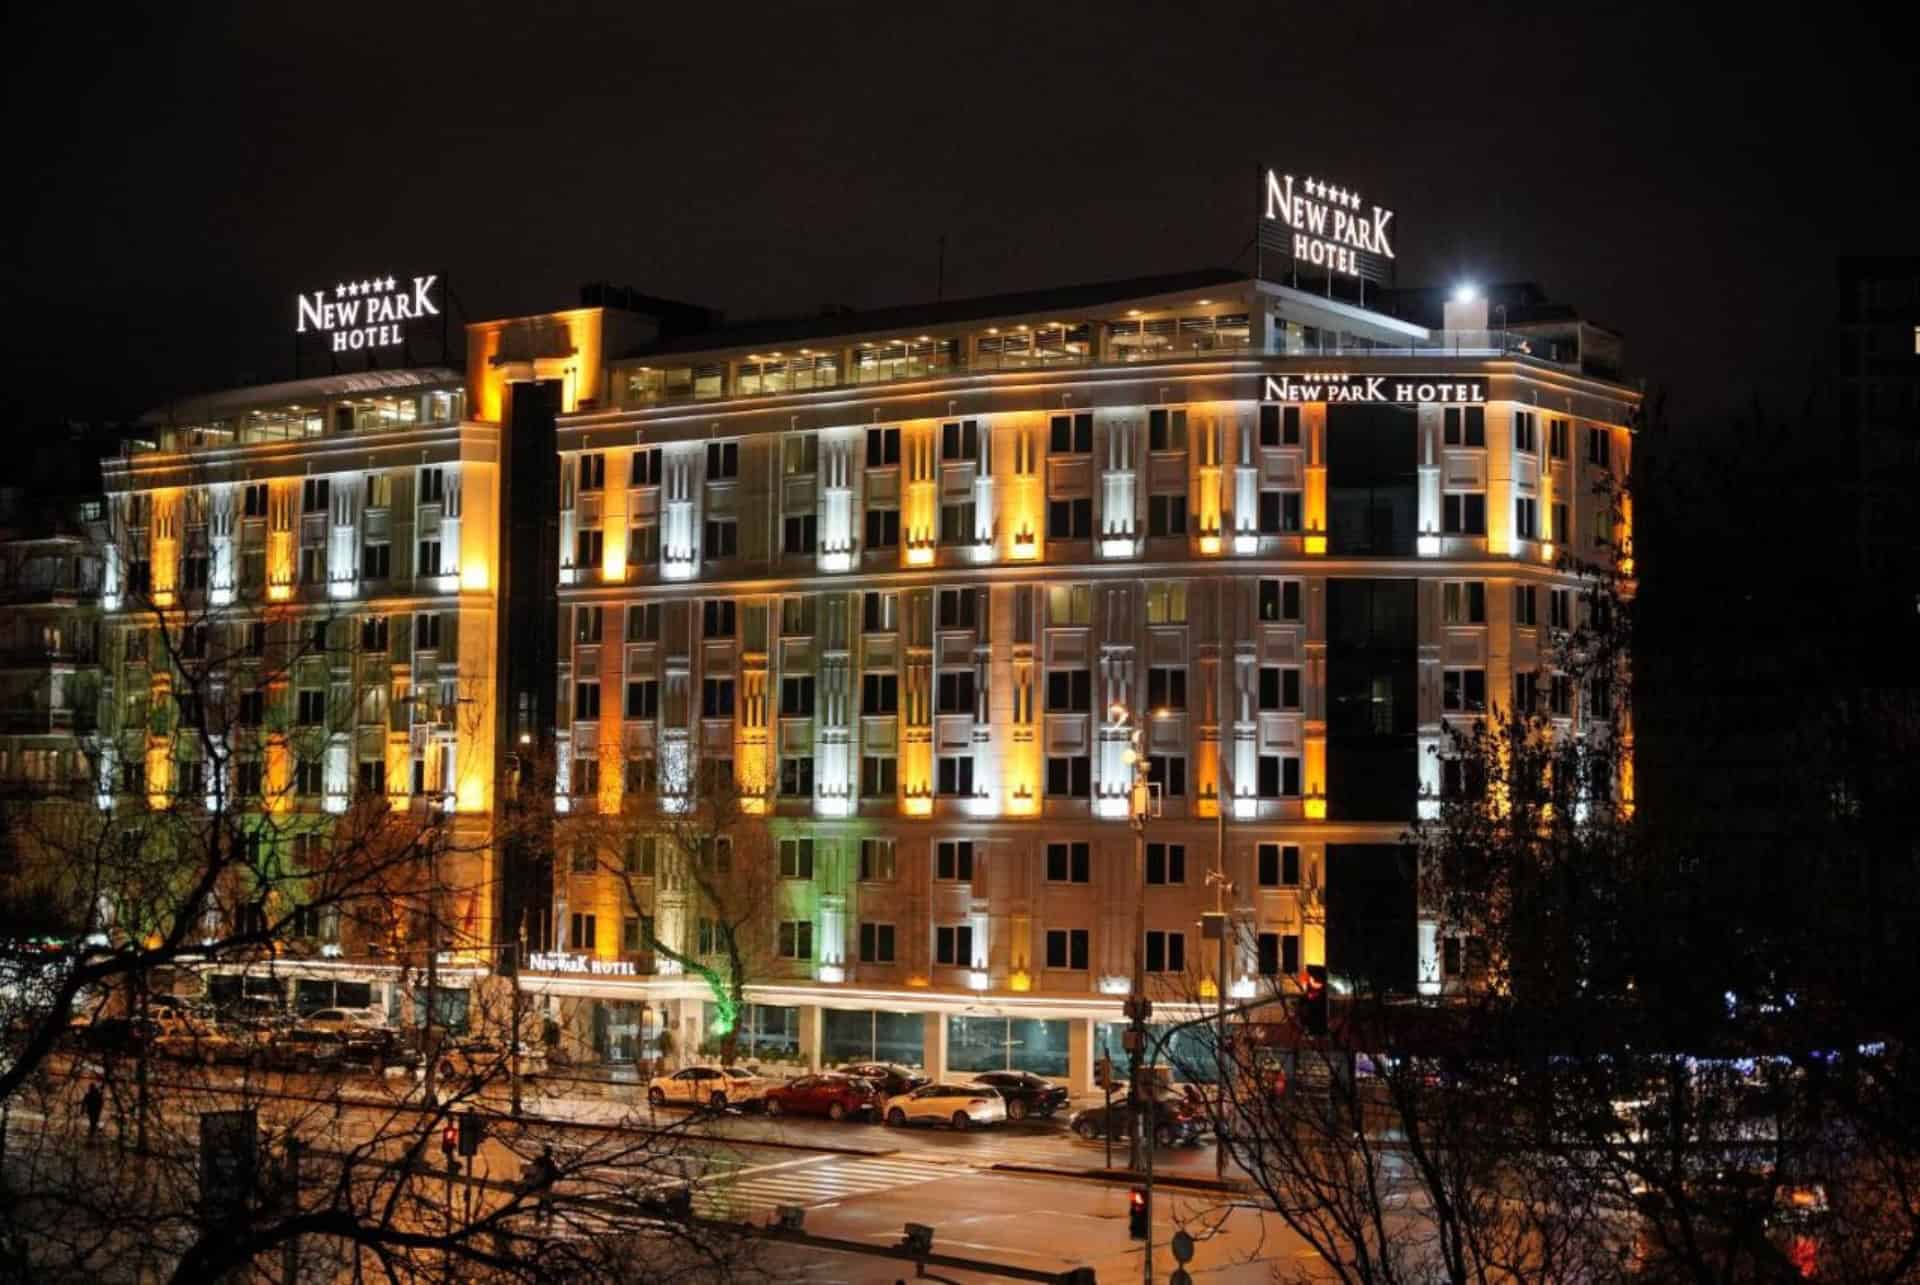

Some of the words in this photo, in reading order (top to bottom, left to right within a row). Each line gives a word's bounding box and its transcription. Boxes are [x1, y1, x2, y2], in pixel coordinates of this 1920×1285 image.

[1265, 168, 1328, 236] NEW
[1333, 205, 1395, 259] PARK
[1295, 233, 1359, 276] HOTEL
[296, 291, 360, 332] NEW
[366, 275, 440, 323] PARK
[333, 324, 403, 352] HOTEL
[1264, 376, 1321, 401] NEW
[1328, 376, 1387, 402] PARK
[1396, 384, 1484, 402] HOTEL
[591, 960, 637, 976] HOTEL
